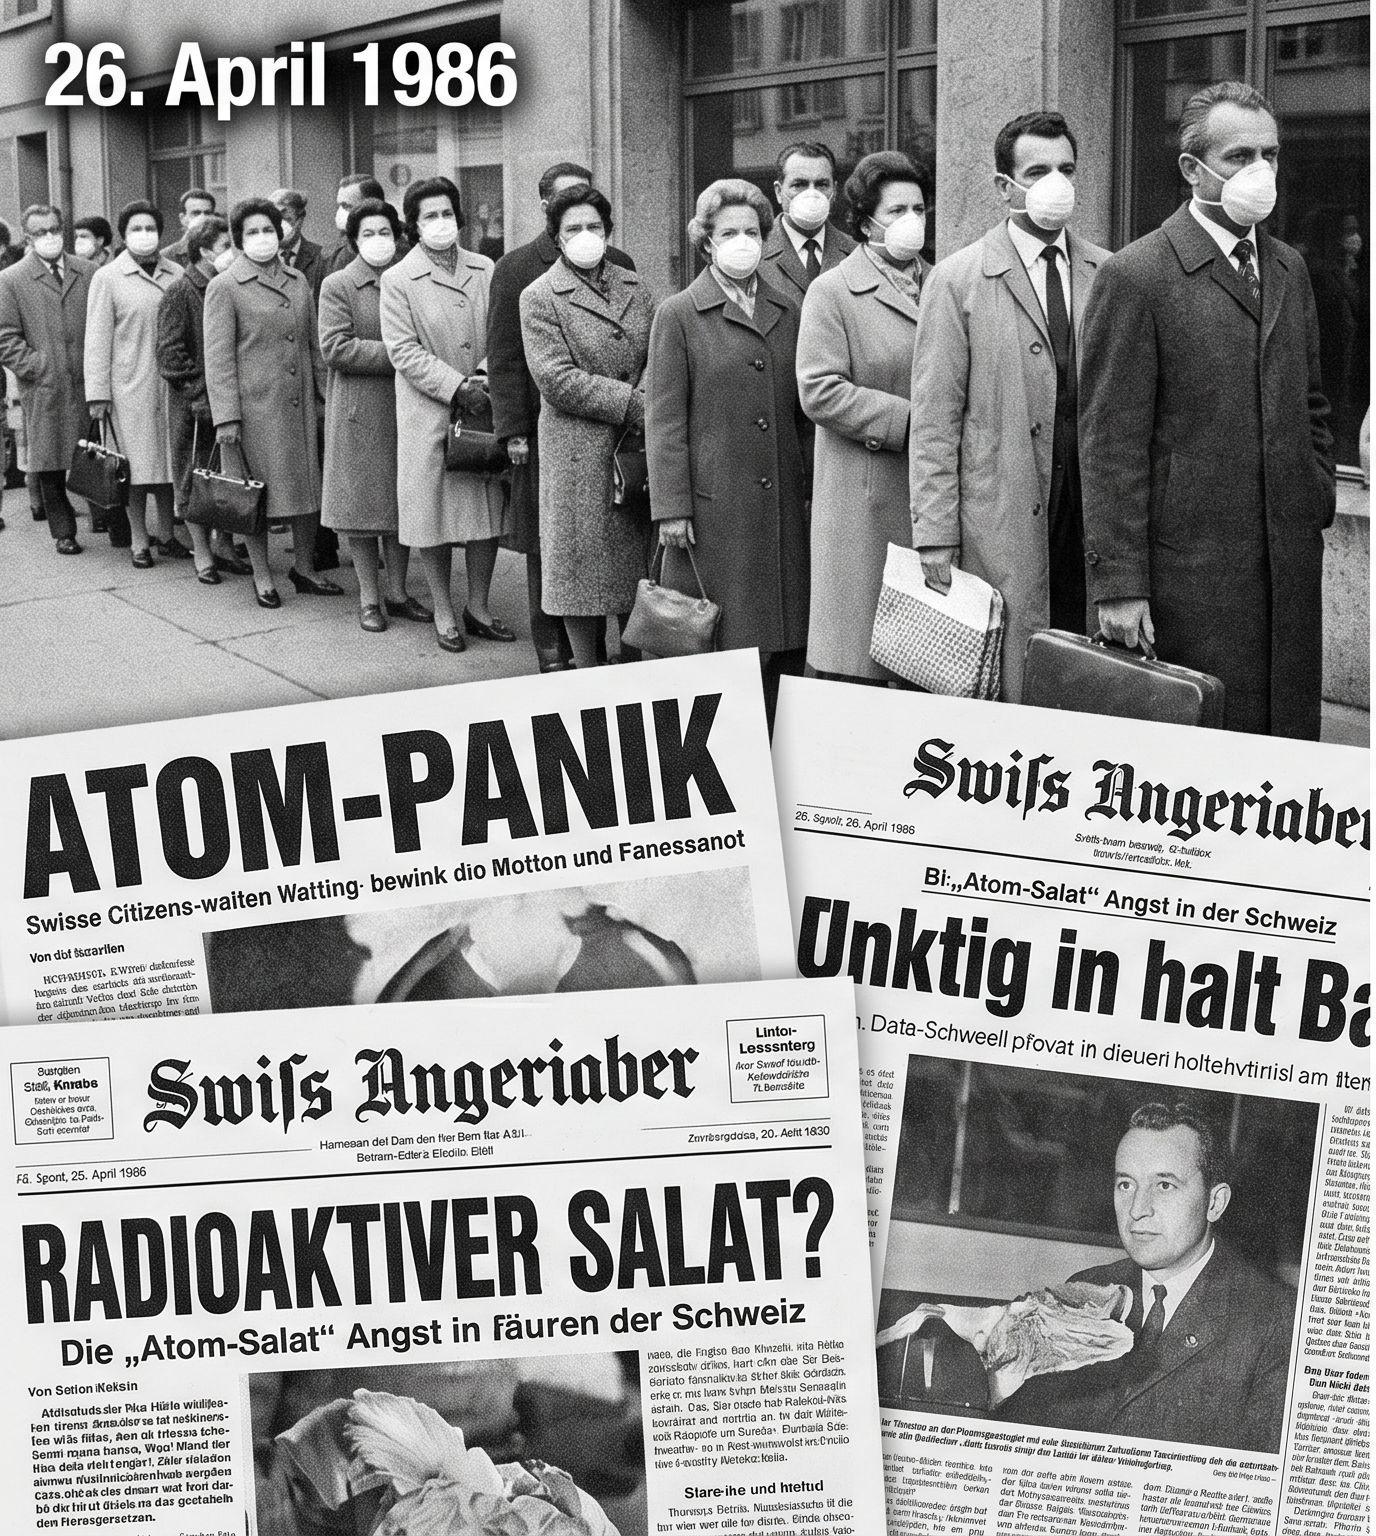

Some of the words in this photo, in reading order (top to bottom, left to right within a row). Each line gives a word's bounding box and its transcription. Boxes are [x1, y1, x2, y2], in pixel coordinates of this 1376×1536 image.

[22, 692, 737, 900] ATOM-PANIK
[795, 811, 809, 821] 26.
[846, 818, 861, 827] 26.
[864, 820, 887, 831] April
[891, 824, 915, 834] 1986
[26, 912, 101, 934] Swisse
[371, 866, 448, 892] bewink
[492, 855, 566, 877] Motton
[573, 845, 612, 867] und
[619, 830, 745, 861] Fanessanot
[1104, 890, 1169, 916] Angst
[1176, 898, 1195, 918] in
[1203, 903, 1239, 923] der
[1245, 907, 1337, 935] Schweiz
[30, 953, 51, 963] Von
[1052, 928, 1119, 1015] in
[1141, 939, 1281, 1036] halt
[871, 1014, 1008, 1047] Data-Schweell
[1081, 1040, 1096, 1058] in
[1299, 1071, 1327, 1086] am
[417, 1135, 435, 1144] den
[761, 1129, 777, 1138] 20.
[71, 1171, 87, 1181] 25.
[92, 1168, 116, 1182] April
[120, 1167, 146, 1177] 1986
[22, 1195, 541, 1324] RADIOAKTIVER
[568, 1177, 834, 1292] SALAT?
[61, 1339, 113, 1366] Die
[347, 1320, 442, 1353] Angst
[453, 1317, 480, 1343] in
[610, 1307, 662, 1333] der
[673, 1298, 805, 1330] Schweiz
[28, 1387, 52, 1397] Von
[751, 1483, 775, 1495] und
